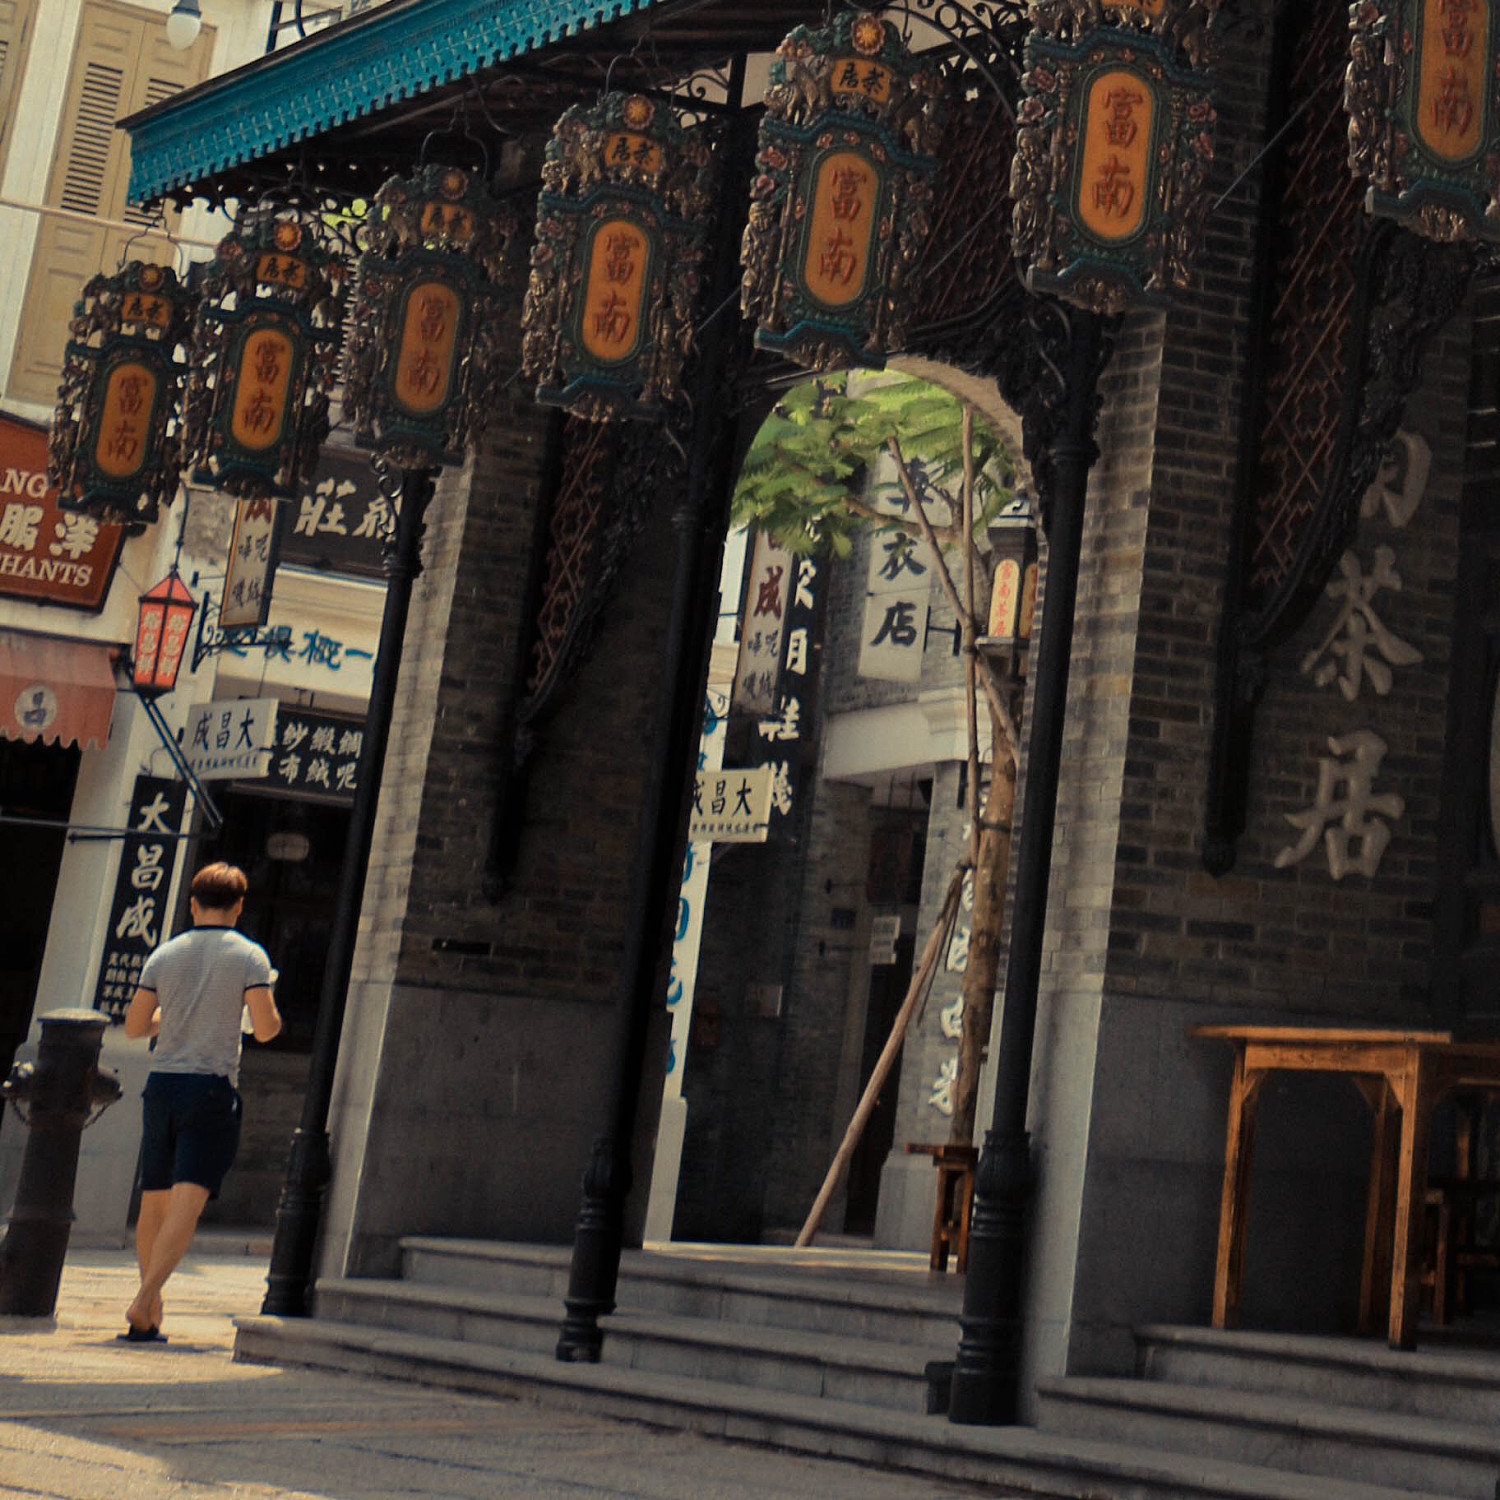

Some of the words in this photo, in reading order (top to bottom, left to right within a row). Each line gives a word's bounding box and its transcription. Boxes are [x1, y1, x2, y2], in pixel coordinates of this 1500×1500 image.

[1091, 85, 1147, 220] 富南
[816, 165, 869, 288] 富南
[592, 231, 641, 343] 富南
[241, 337, 292, 436] 富南
[405, 295, 455, 397] 富南
[105, 376, 143, 464] 富南
[192, 707, 255, 751] 大昌成
[115, 791, 172, 949] 大昌成
